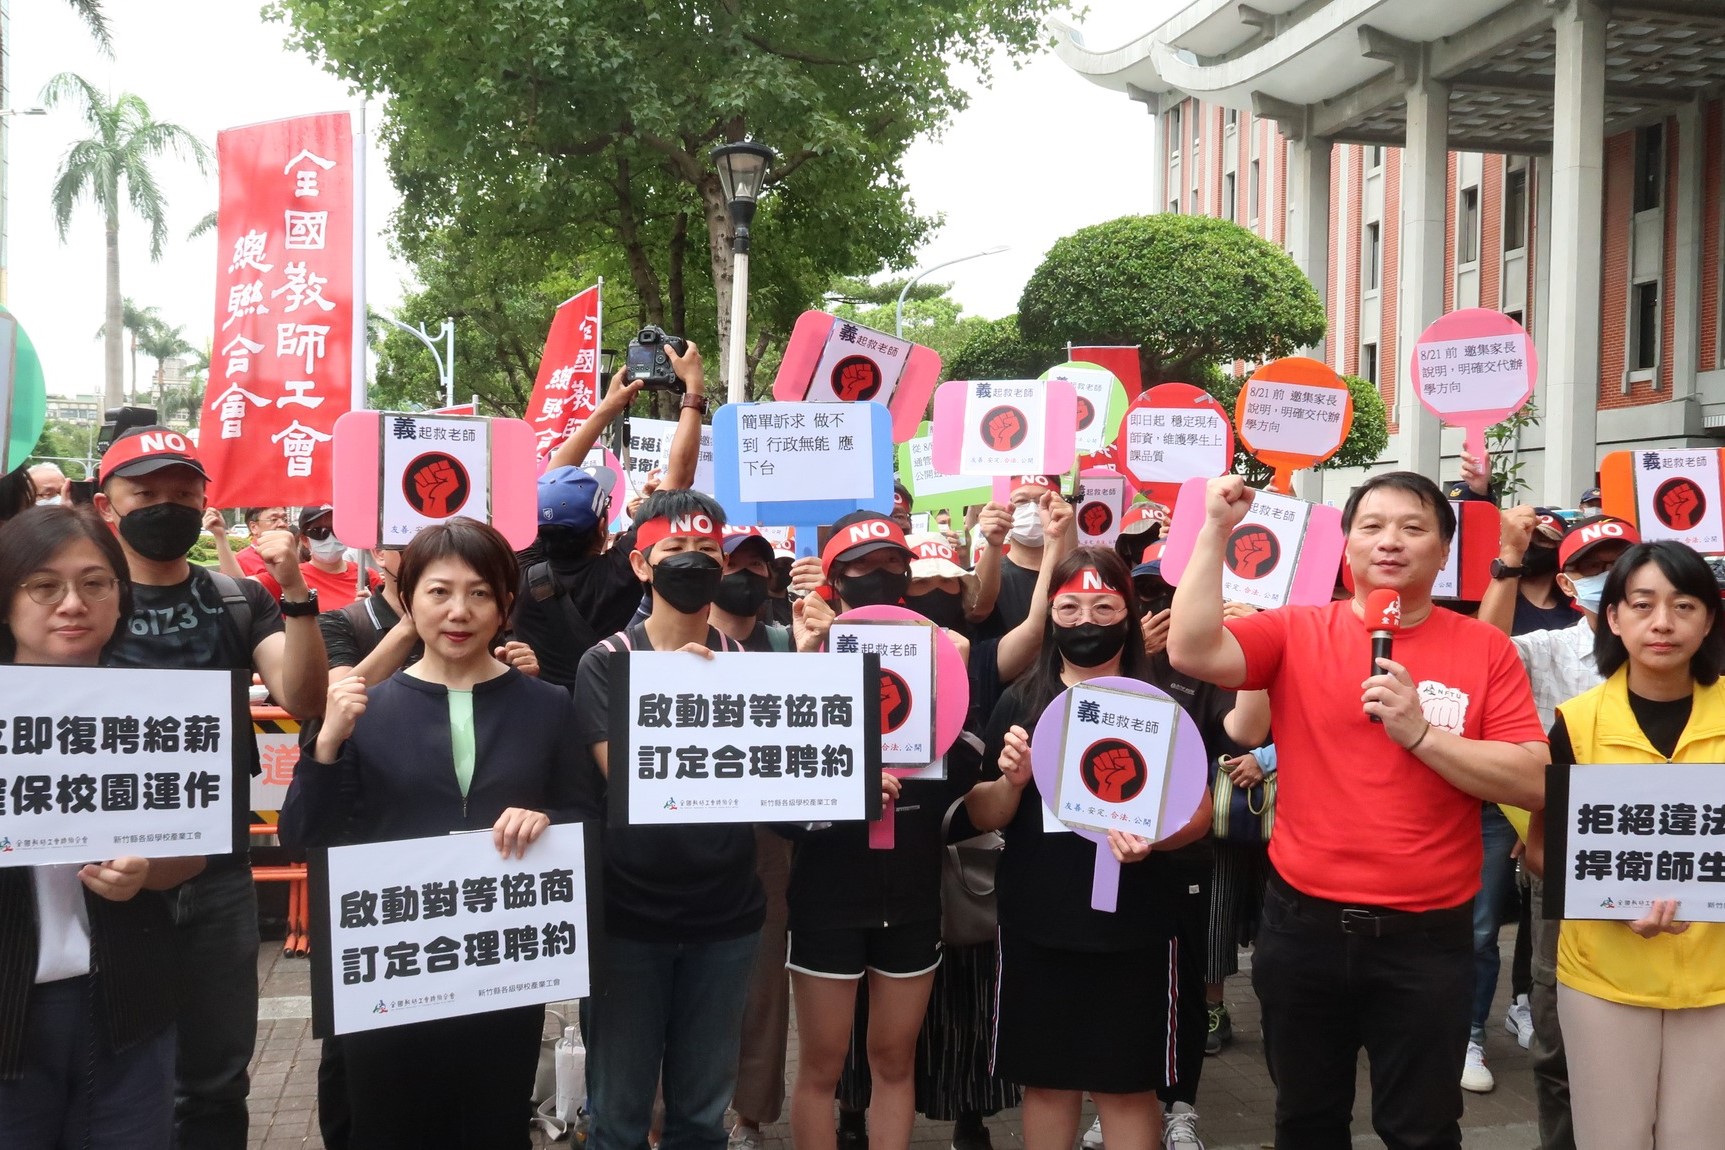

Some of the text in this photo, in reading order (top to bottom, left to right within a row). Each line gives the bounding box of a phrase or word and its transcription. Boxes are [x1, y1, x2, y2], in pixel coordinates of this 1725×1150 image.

[271, 149, 336, 477] 全國教師工會
[211, 229, 274, 439] 總聯合會
[839, 324, 899, 357] 義起救老師
[1421, 341, 1516, 360] 8/21 前 邀集家長
[976, 383, 1034, 398] 義起救老師
[1250, 387, 1337, 406] 8/21 前 邀集家長
[1423, 383, 1461, 395] 學方向
[535, 366, 575, 462] 總聯合
[742, 412, 845, 430] 簡單訴求 做不
[1130, 414, 1219, 428] 即日起 穩定現有
[393, 417, 476, 442] 義起救老師
[1245, 419, 1280, 433] 學方向
[140, 433, 186, 452] NO
[742, 435, 854, 453] 到 行政無能 應
[1129, 450, 1164, 462] 課品質
[1643, 452, 1707, 470] 義起救老師
[743, 460, 775, 476] 下台
[1021, 475, 1049, 485] NO
[1142, 509, 1164, 520] NO
[671, 515, 713, 534] NO
[850, 522, 890, 542] NO
[1581, 523, 1623, 542] NO
[921, 543, 952, 558] NO
[837, 634, 917, 657] 義起救老師
[1437, 689, 1461, 699] NFTU
[638, 693, 853, 729] 啟動對等協商
[1077, 700, 1159, 734] 義起救老師
[0, 715, 220, 755] 即復聘給薪
[638, 744, 853, 779] 訂定合理聘約
[0, 771, 220, 815] 保校園運作
[1575, 850, 1725, 882] 捍衛師生
[340, 868, 574, 928] 啟動對等協商
[341, 921, 576, 985] 訂定合理聘約
